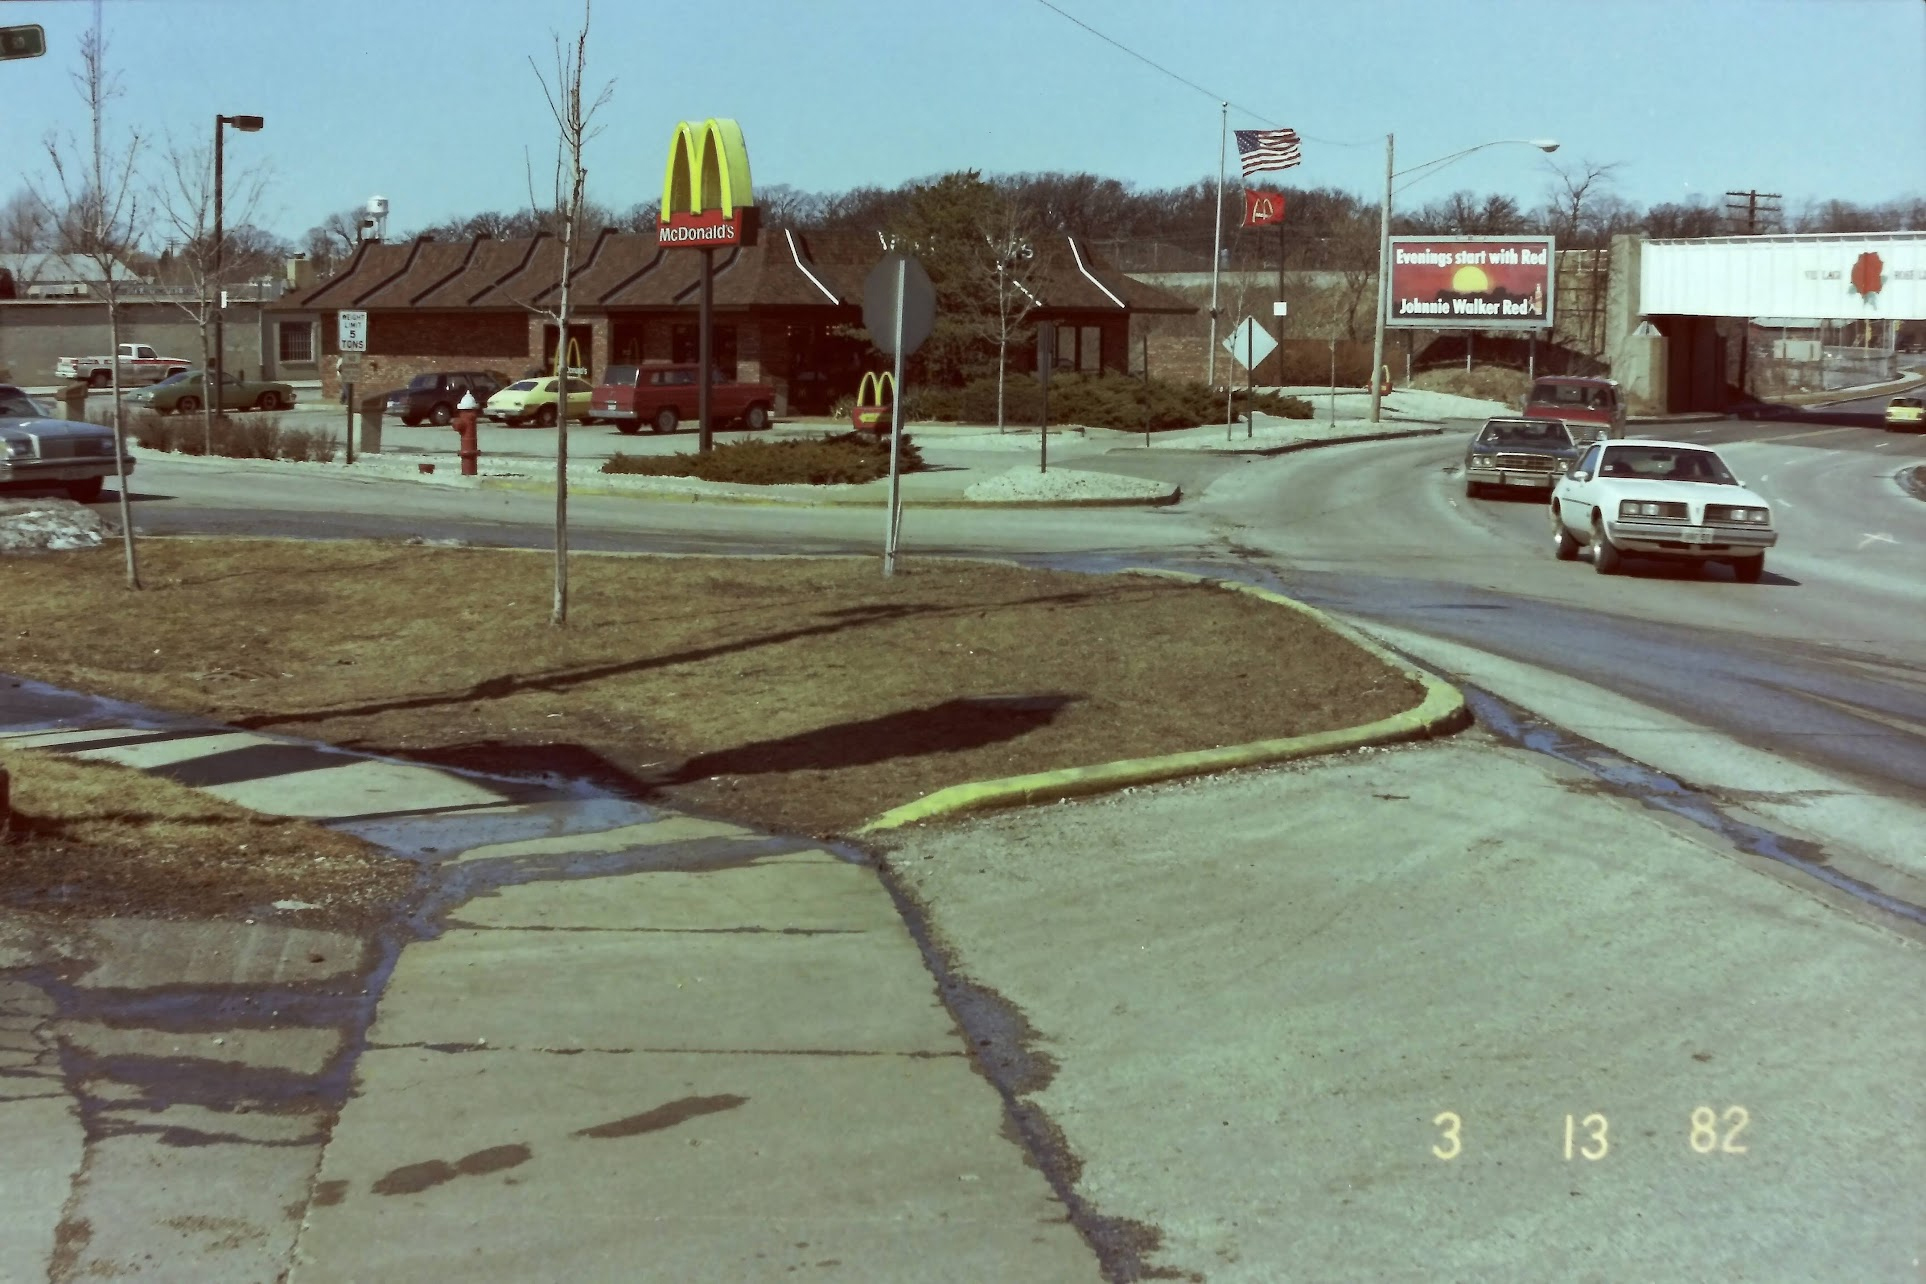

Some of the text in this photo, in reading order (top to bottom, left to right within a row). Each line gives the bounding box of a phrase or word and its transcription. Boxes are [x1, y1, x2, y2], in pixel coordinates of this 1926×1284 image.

[660, 225, 734, 242] McDonald's
[1396, 248, 1547, 268] Evenings start with Red
[1400, 297, 1528, 315] Johnnie Walker Red
[344, 321, 362, 329] LIMIT
[349, 330, 356, 339] 5
[342, 340, 364, 349] TONS
